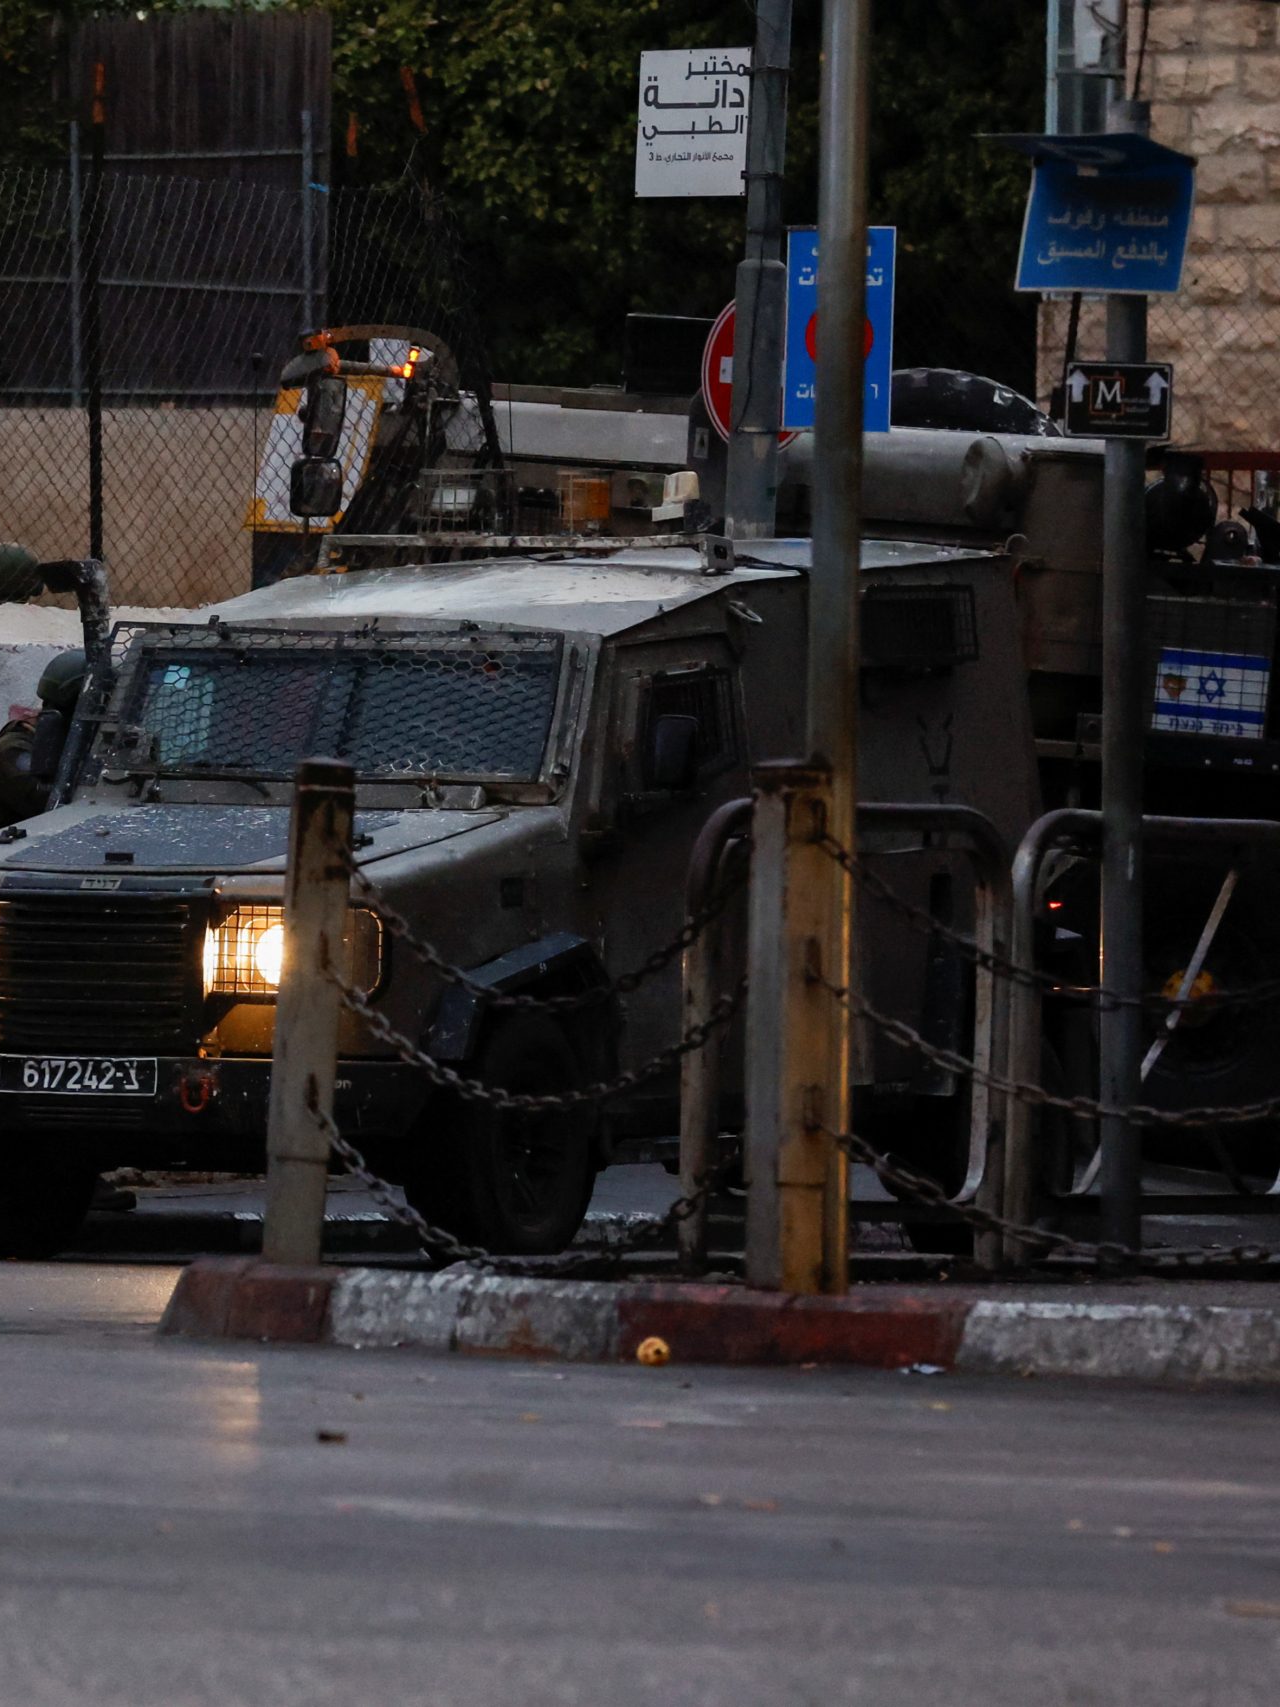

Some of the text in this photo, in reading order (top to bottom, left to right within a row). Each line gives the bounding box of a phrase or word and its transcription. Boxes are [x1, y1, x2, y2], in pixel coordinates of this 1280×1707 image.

[685, 56, 751, 80] مختبر
[643, 76, 745, 109] دانة
[642, 115, 744, 147] الطبي
[648, 152, 655, 162] 3
[1037, 238, 1106, 265] المسبق
